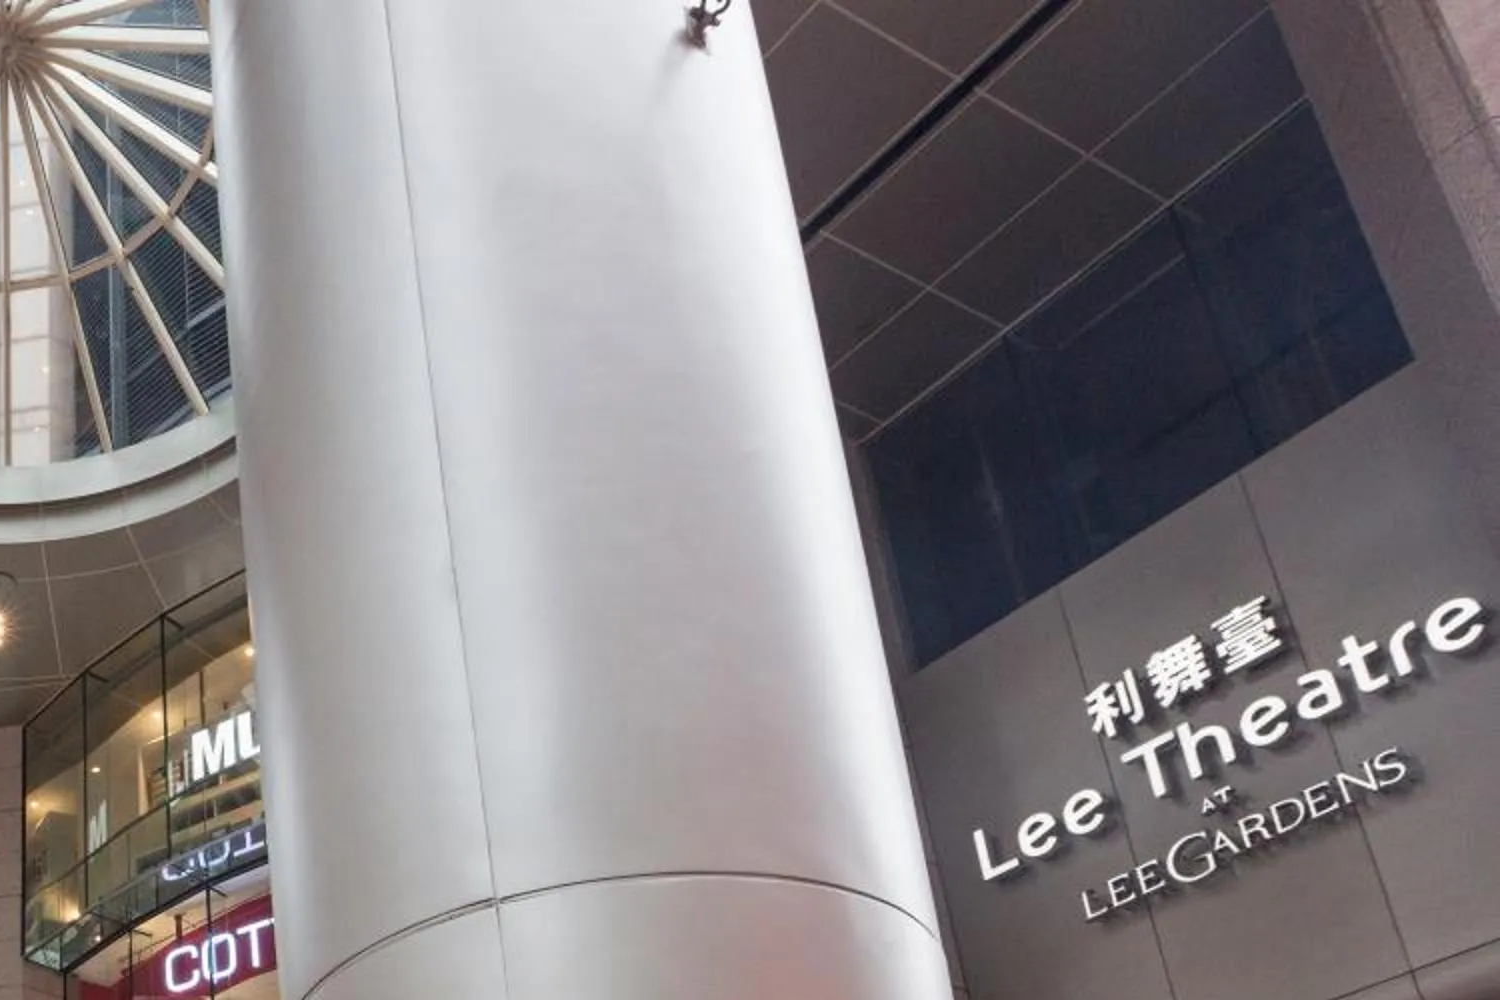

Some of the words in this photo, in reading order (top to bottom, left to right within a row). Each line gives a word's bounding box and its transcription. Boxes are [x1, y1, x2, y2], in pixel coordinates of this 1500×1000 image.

[1084, 595, 1282, 738] 利舞臺
[972, 787, 1106, 881] Lee
[1120, 596, 1486, 799] Theatre
[1200, 785, 1235, 815] AT
[165, 918, 275, 993] COT
